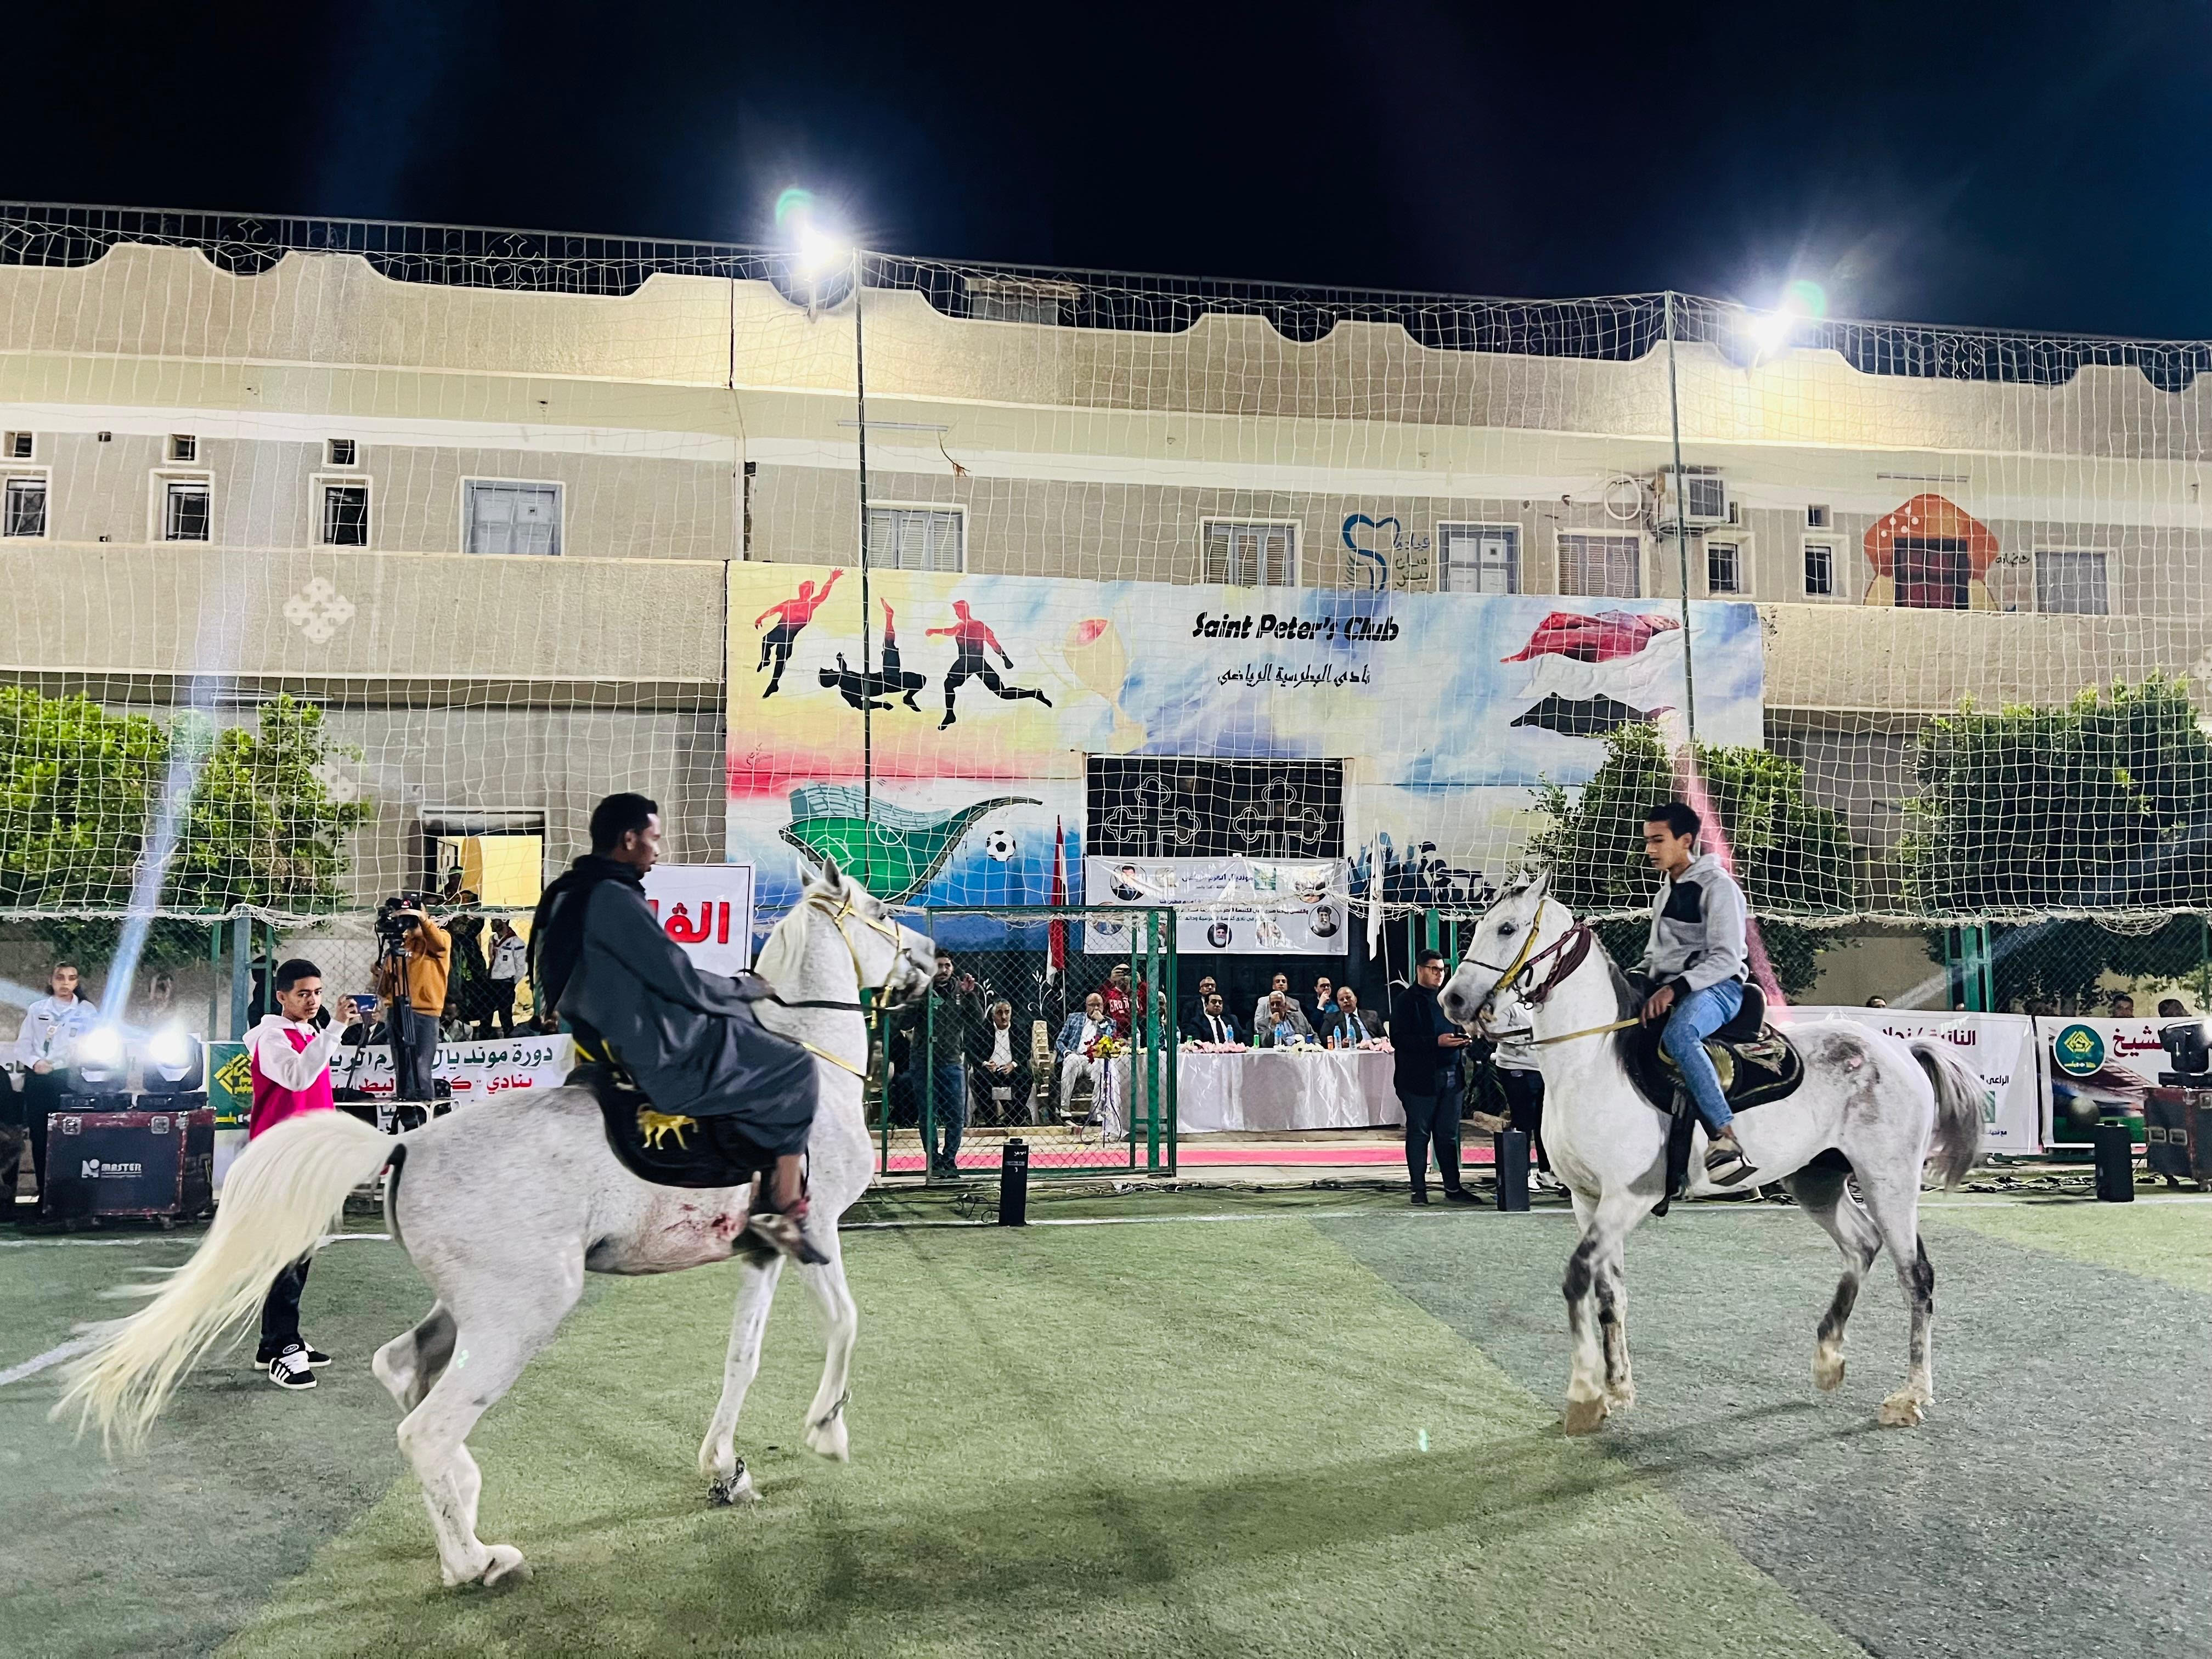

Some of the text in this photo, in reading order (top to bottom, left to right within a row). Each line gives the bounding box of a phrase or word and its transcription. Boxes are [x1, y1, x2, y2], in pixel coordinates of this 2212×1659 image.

[1193, 611, 1400, 641] Saint Peter's Club
[512, 1043, 553, 1067] دورة
[2113, 1025, 2163, 1058] شيخ
